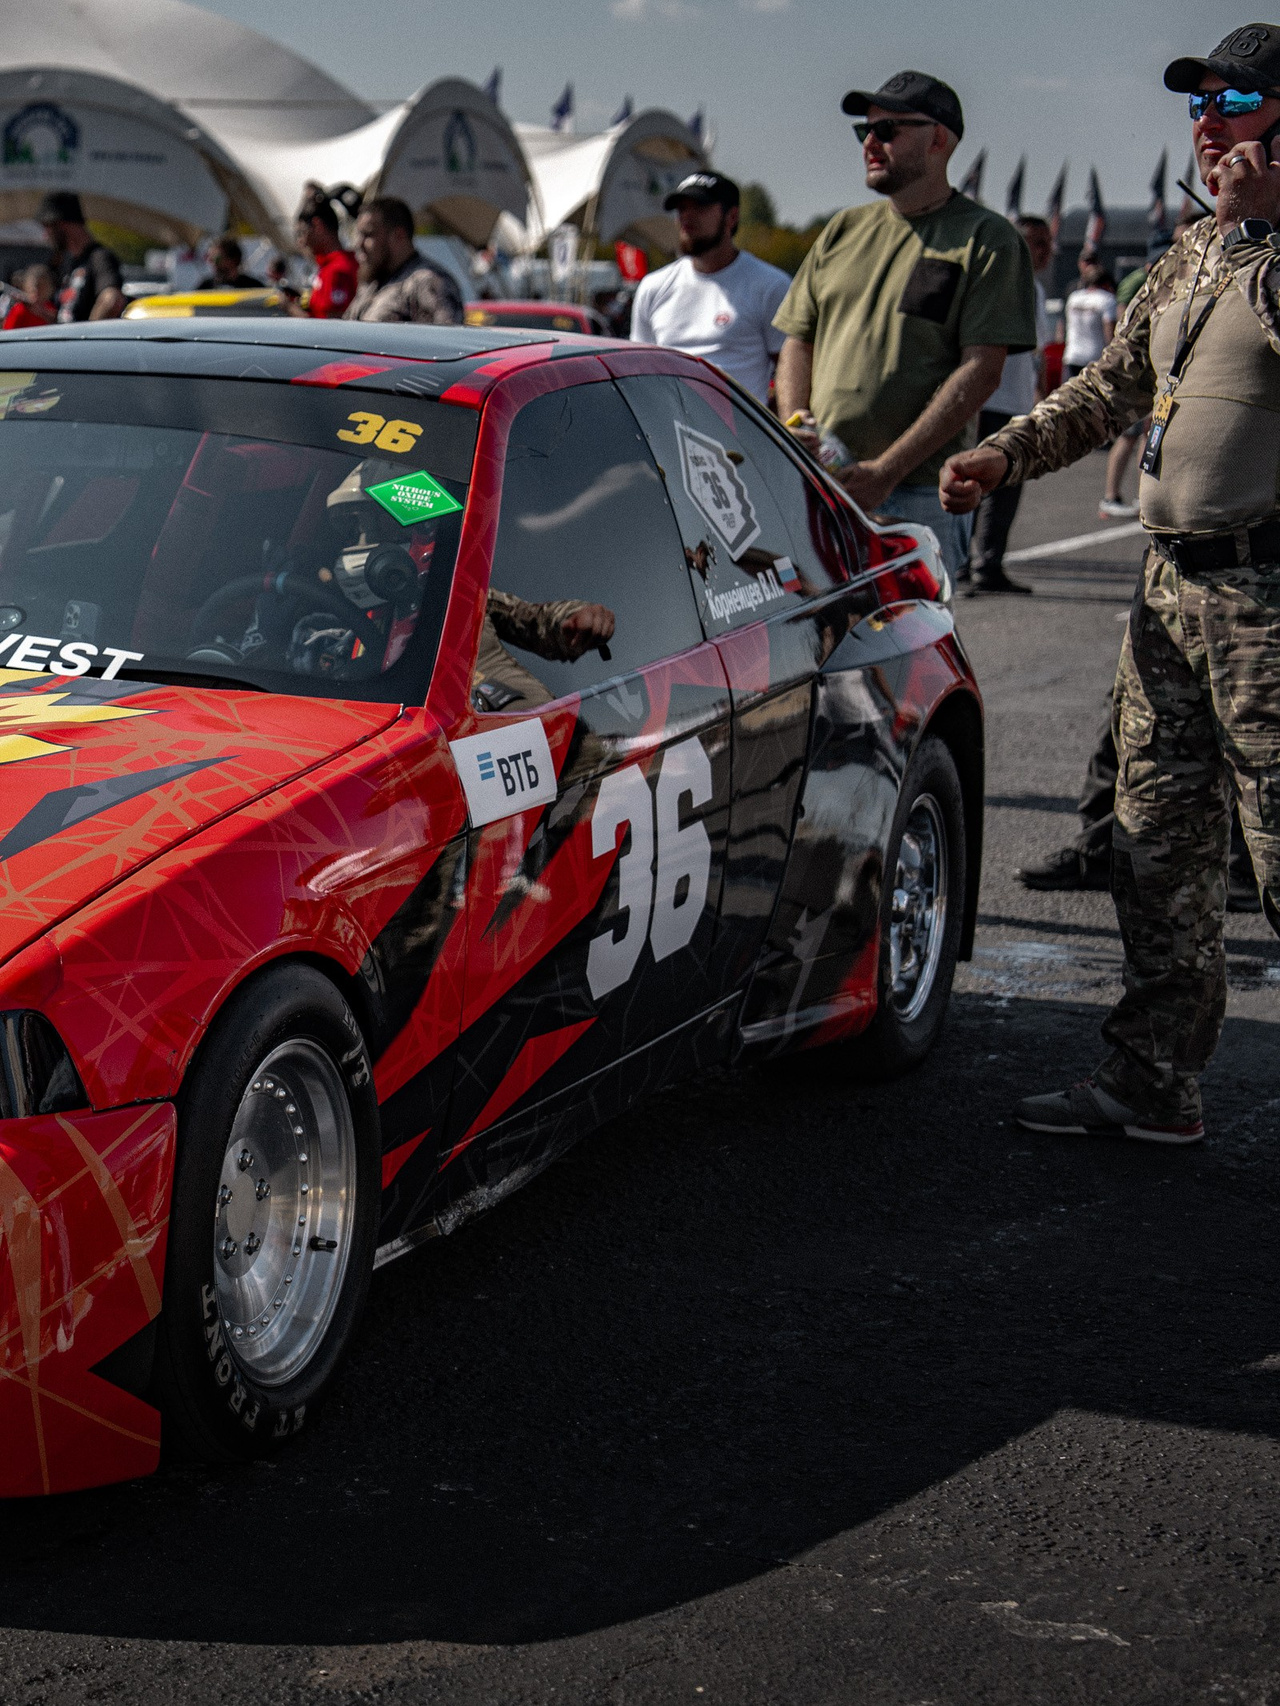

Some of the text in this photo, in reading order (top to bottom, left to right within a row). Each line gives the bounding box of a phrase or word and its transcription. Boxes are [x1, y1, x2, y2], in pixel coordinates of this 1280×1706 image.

[336, 411, 424, 454] 36
[390, 495, 434, 509] SYSTEM
[391, 483, 441, 498] NITROUS
[397, 491, 431, 502] OXIDE
[701, 470, 732, 510] 36
[704, 581, 765, 624] Корнейцев
[496, 749, 540, 797] ВТБ
[585, 735, 714, 1001] 36
